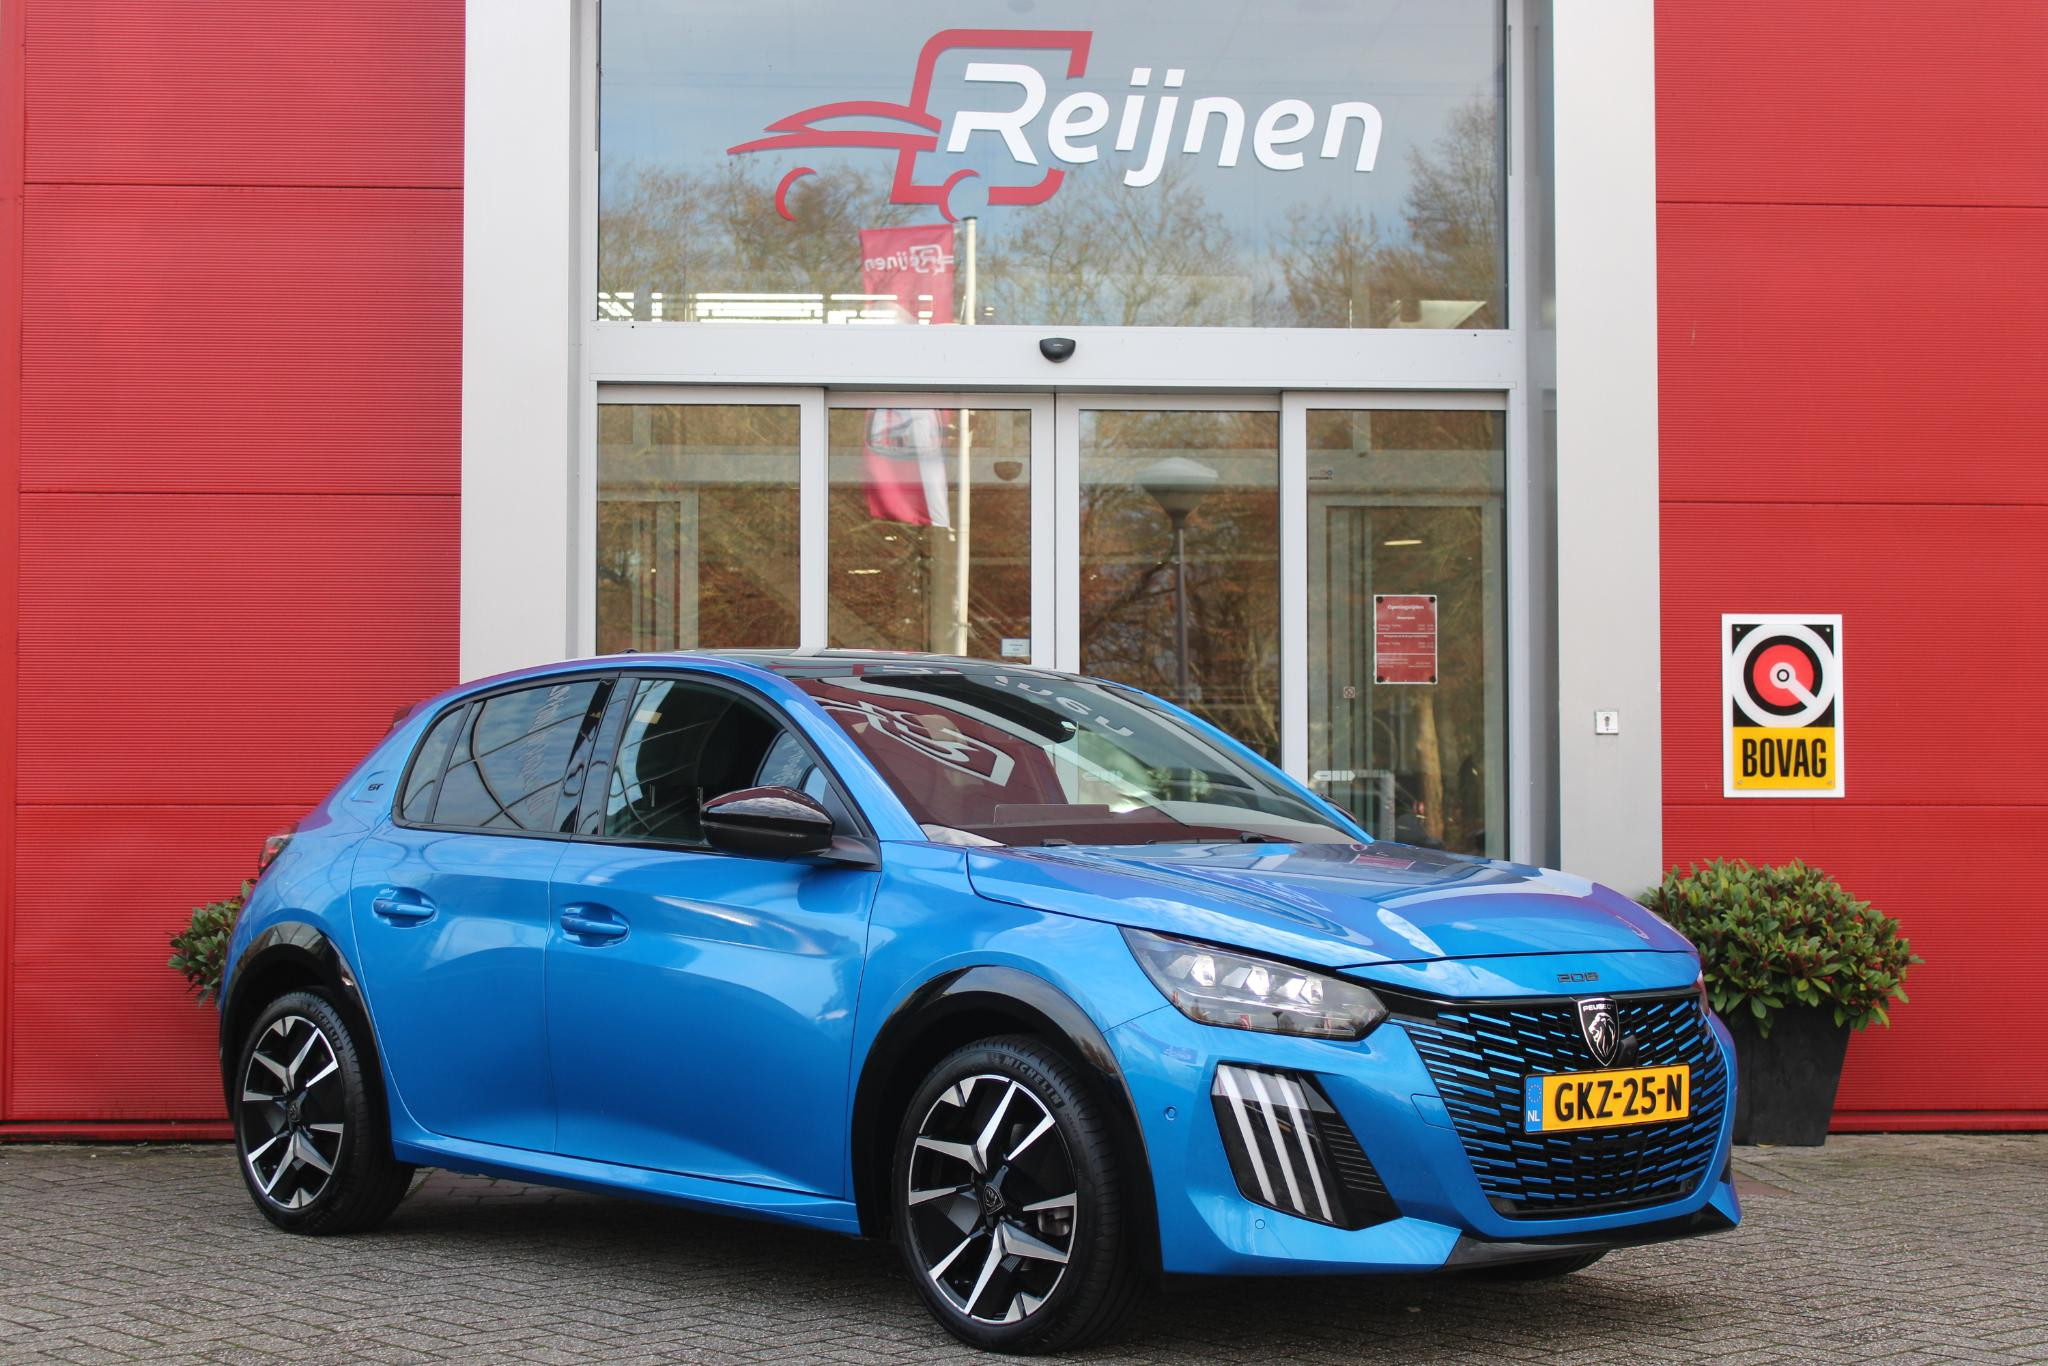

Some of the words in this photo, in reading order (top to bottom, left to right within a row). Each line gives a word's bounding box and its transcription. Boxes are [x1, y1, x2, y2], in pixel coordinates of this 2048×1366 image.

[946, 63, 1383, 188] Reijnen
[1742, 738, 1827, 778] BOVAG
[1557, 972, 1599, 983] 208
[1003, 1056, 1063, 1105] MICHELIN
[1555, 1074, 1683, 1121] GKZ-25-N
[1527, 1109, 1541, 1122] NL
